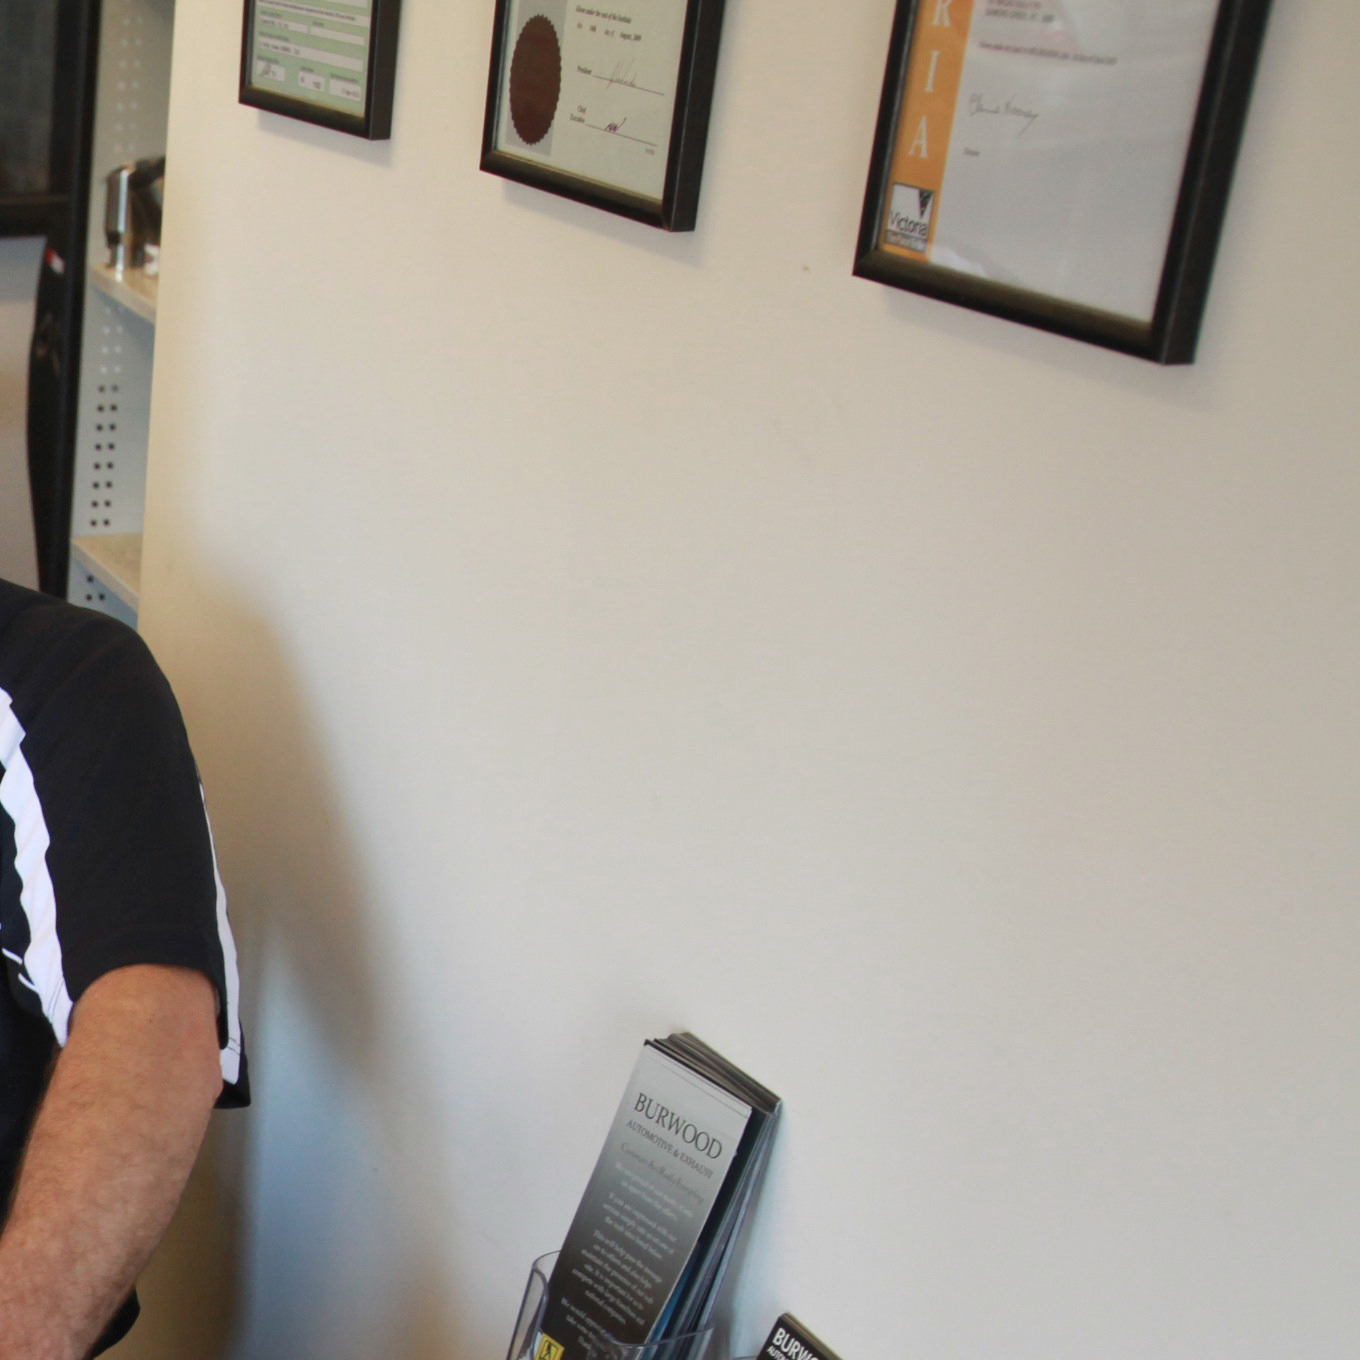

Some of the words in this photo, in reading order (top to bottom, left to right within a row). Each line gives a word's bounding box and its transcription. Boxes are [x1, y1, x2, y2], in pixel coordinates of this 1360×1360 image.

[889, 211, 928, 237] Victoria
[625, 1118, 675, 1153] AUTOMOTIVE
[678, 1152, 714, 1179] EXHAUST
[634, 1093, 723, 1160] BURWOOD
